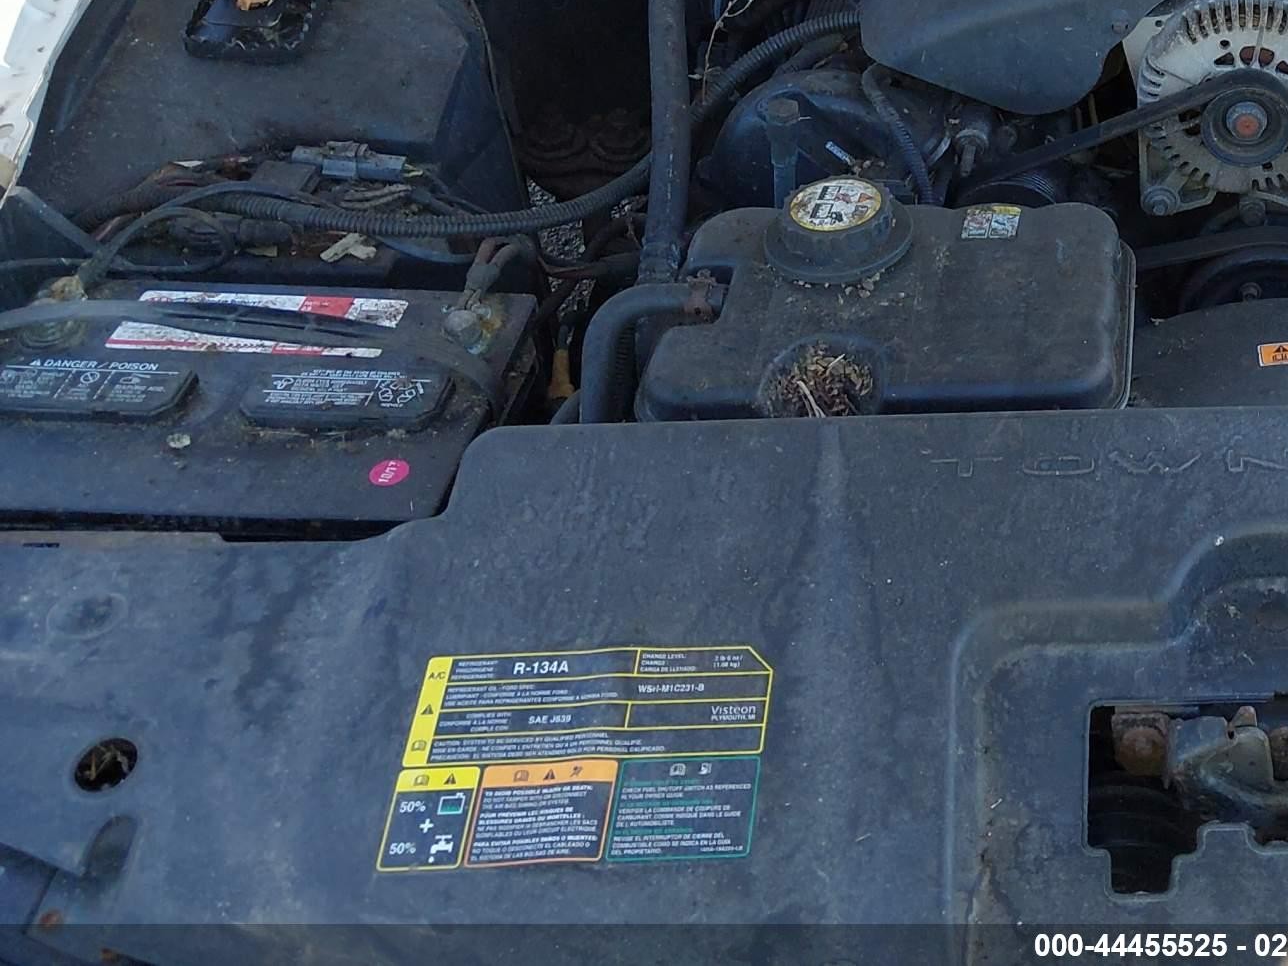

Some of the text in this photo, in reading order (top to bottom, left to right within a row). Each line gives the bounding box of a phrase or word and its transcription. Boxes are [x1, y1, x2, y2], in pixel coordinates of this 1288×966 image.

[44, 359, 97, 369] DANGER
[109, 361, 160, 371] POISON
[513, 661, 569, 675] R-134A
[428, 671, 446, 680] A/C
[711, 705, 756, 715] Visteon
[528, 715, 548, 725] SAE
[399, 801, 426, 813] 50%
[389, 842, 416, 855] 50%
